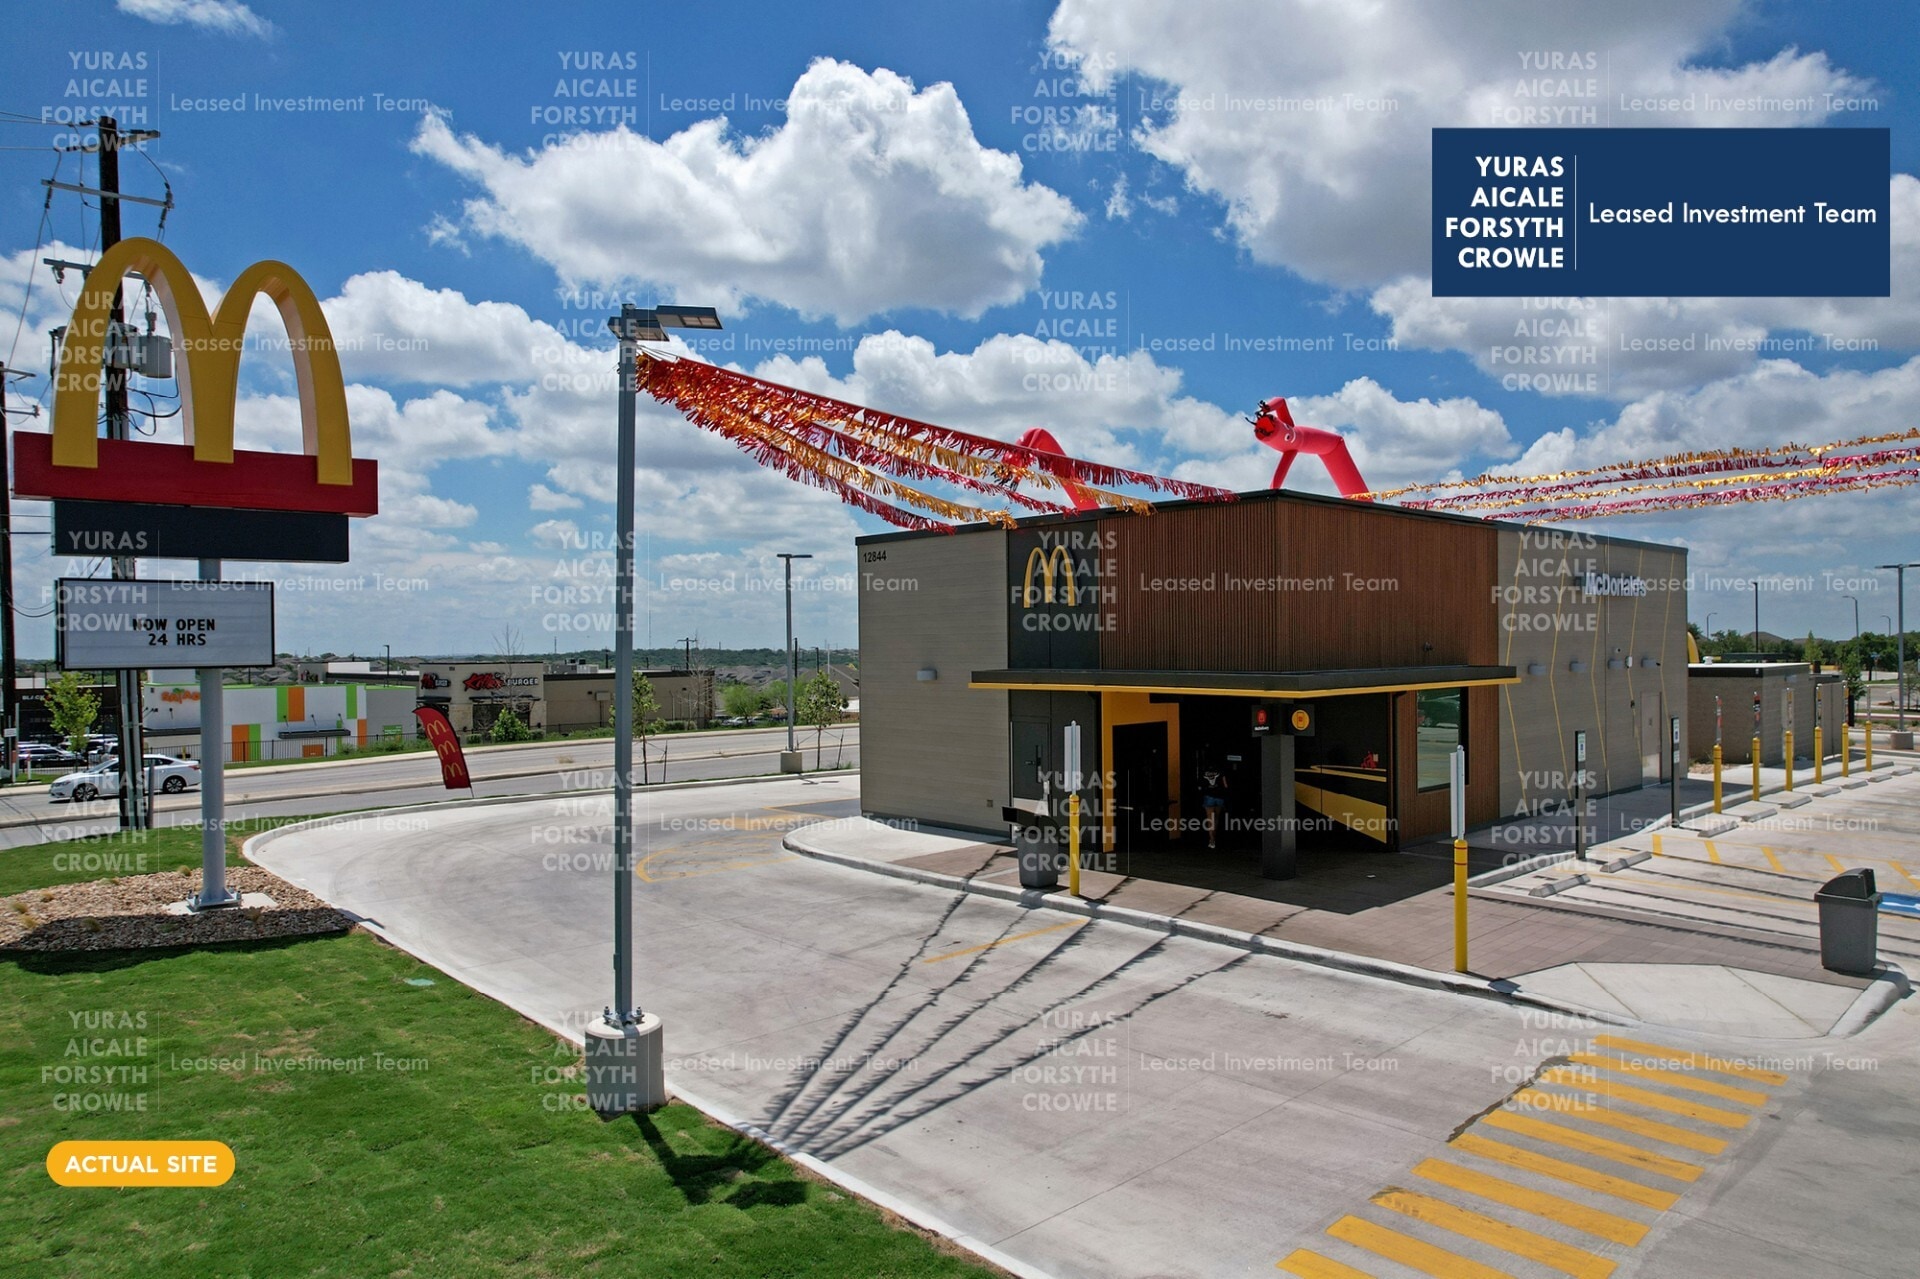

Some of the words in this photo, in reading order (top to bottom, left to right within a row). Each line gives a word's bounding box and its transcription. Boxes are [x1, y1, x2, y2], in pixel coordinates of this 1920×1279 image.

[863, 550, 887, 563] 12844
[132, 618, 168, 631] NOW
[175, 618, 215, 631] OPEN
[148, 633, 168, 646] 24
[176, 633, 207, 646] HRS
[506, 677, 539, 686] BURGER
